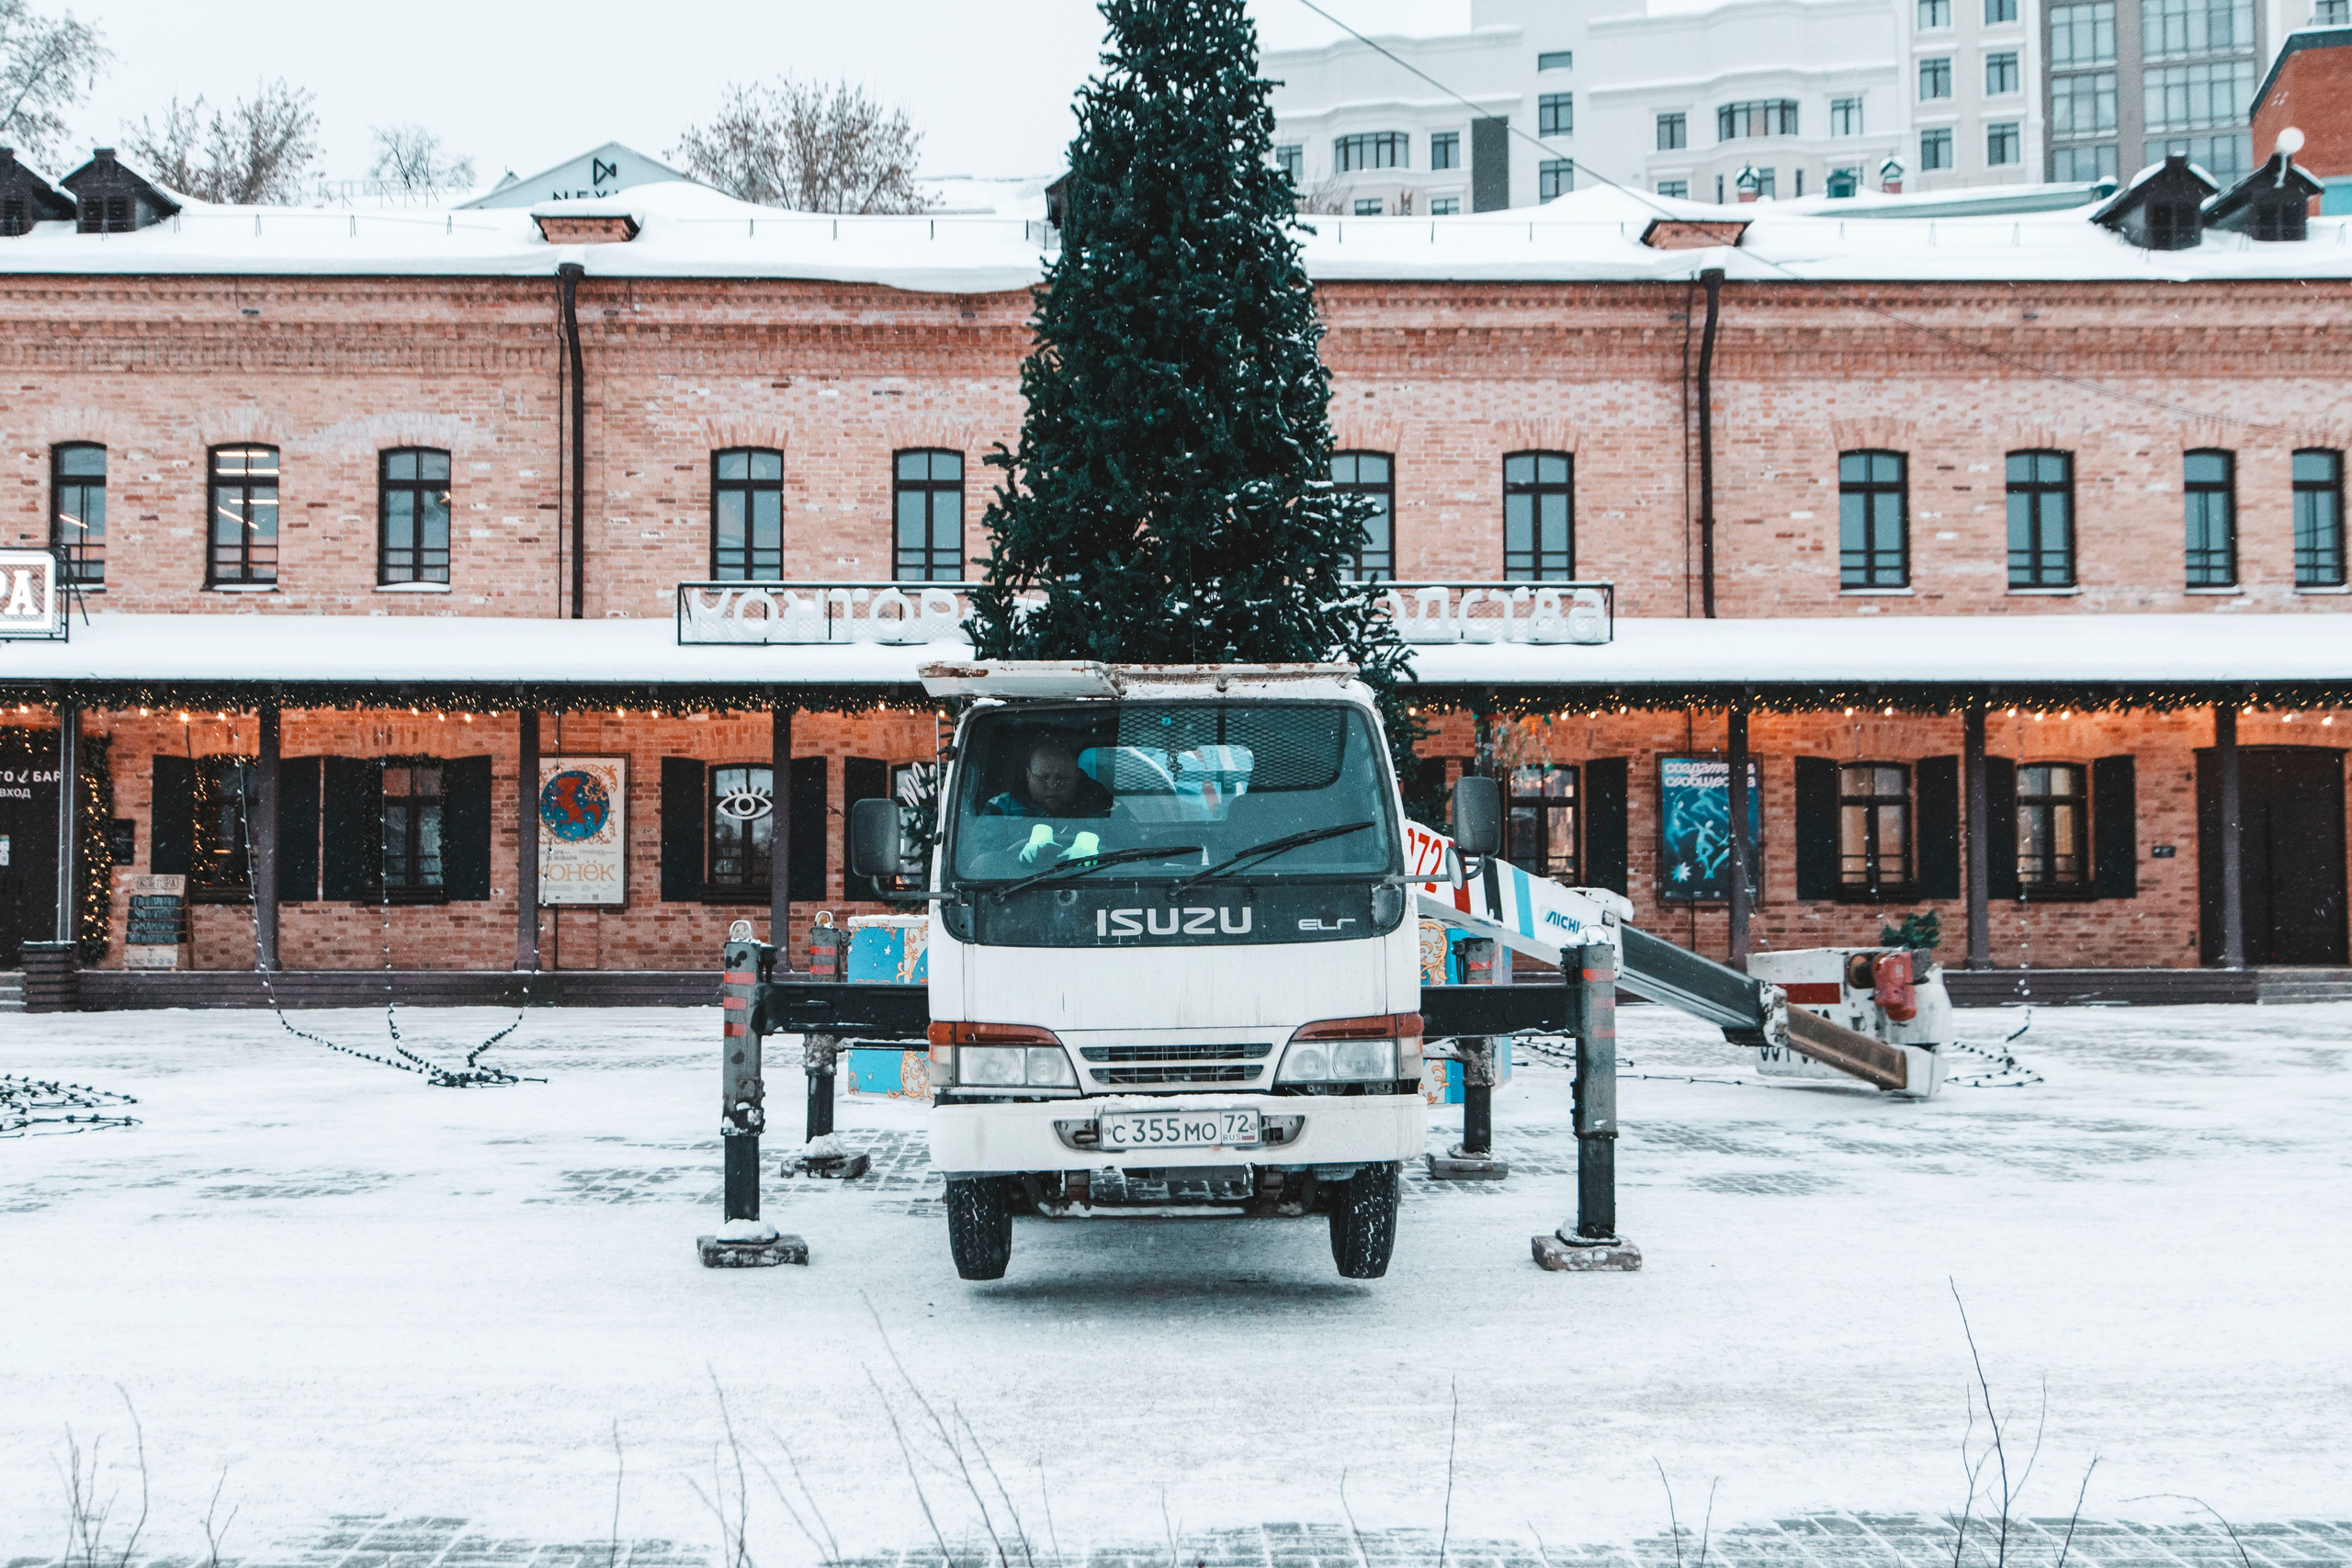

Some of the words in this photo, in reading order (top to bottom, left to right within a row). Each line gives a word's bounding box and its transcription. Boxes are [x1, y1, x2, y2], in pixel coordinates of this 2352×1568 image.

[0, 570, 39, 615] А
[691, 586, 976, 641] КОНТОР
[33, 770, 62, 783] БАР
[0, 787, 31, 800] ВХОД
[1096, 907, 1251, 936] ISUZU
[1544, 909, 1580, 934] AICHI
[1224, 1114, 1250, 1134] 72
[1222, 1133, 1241, 1142] RUS
